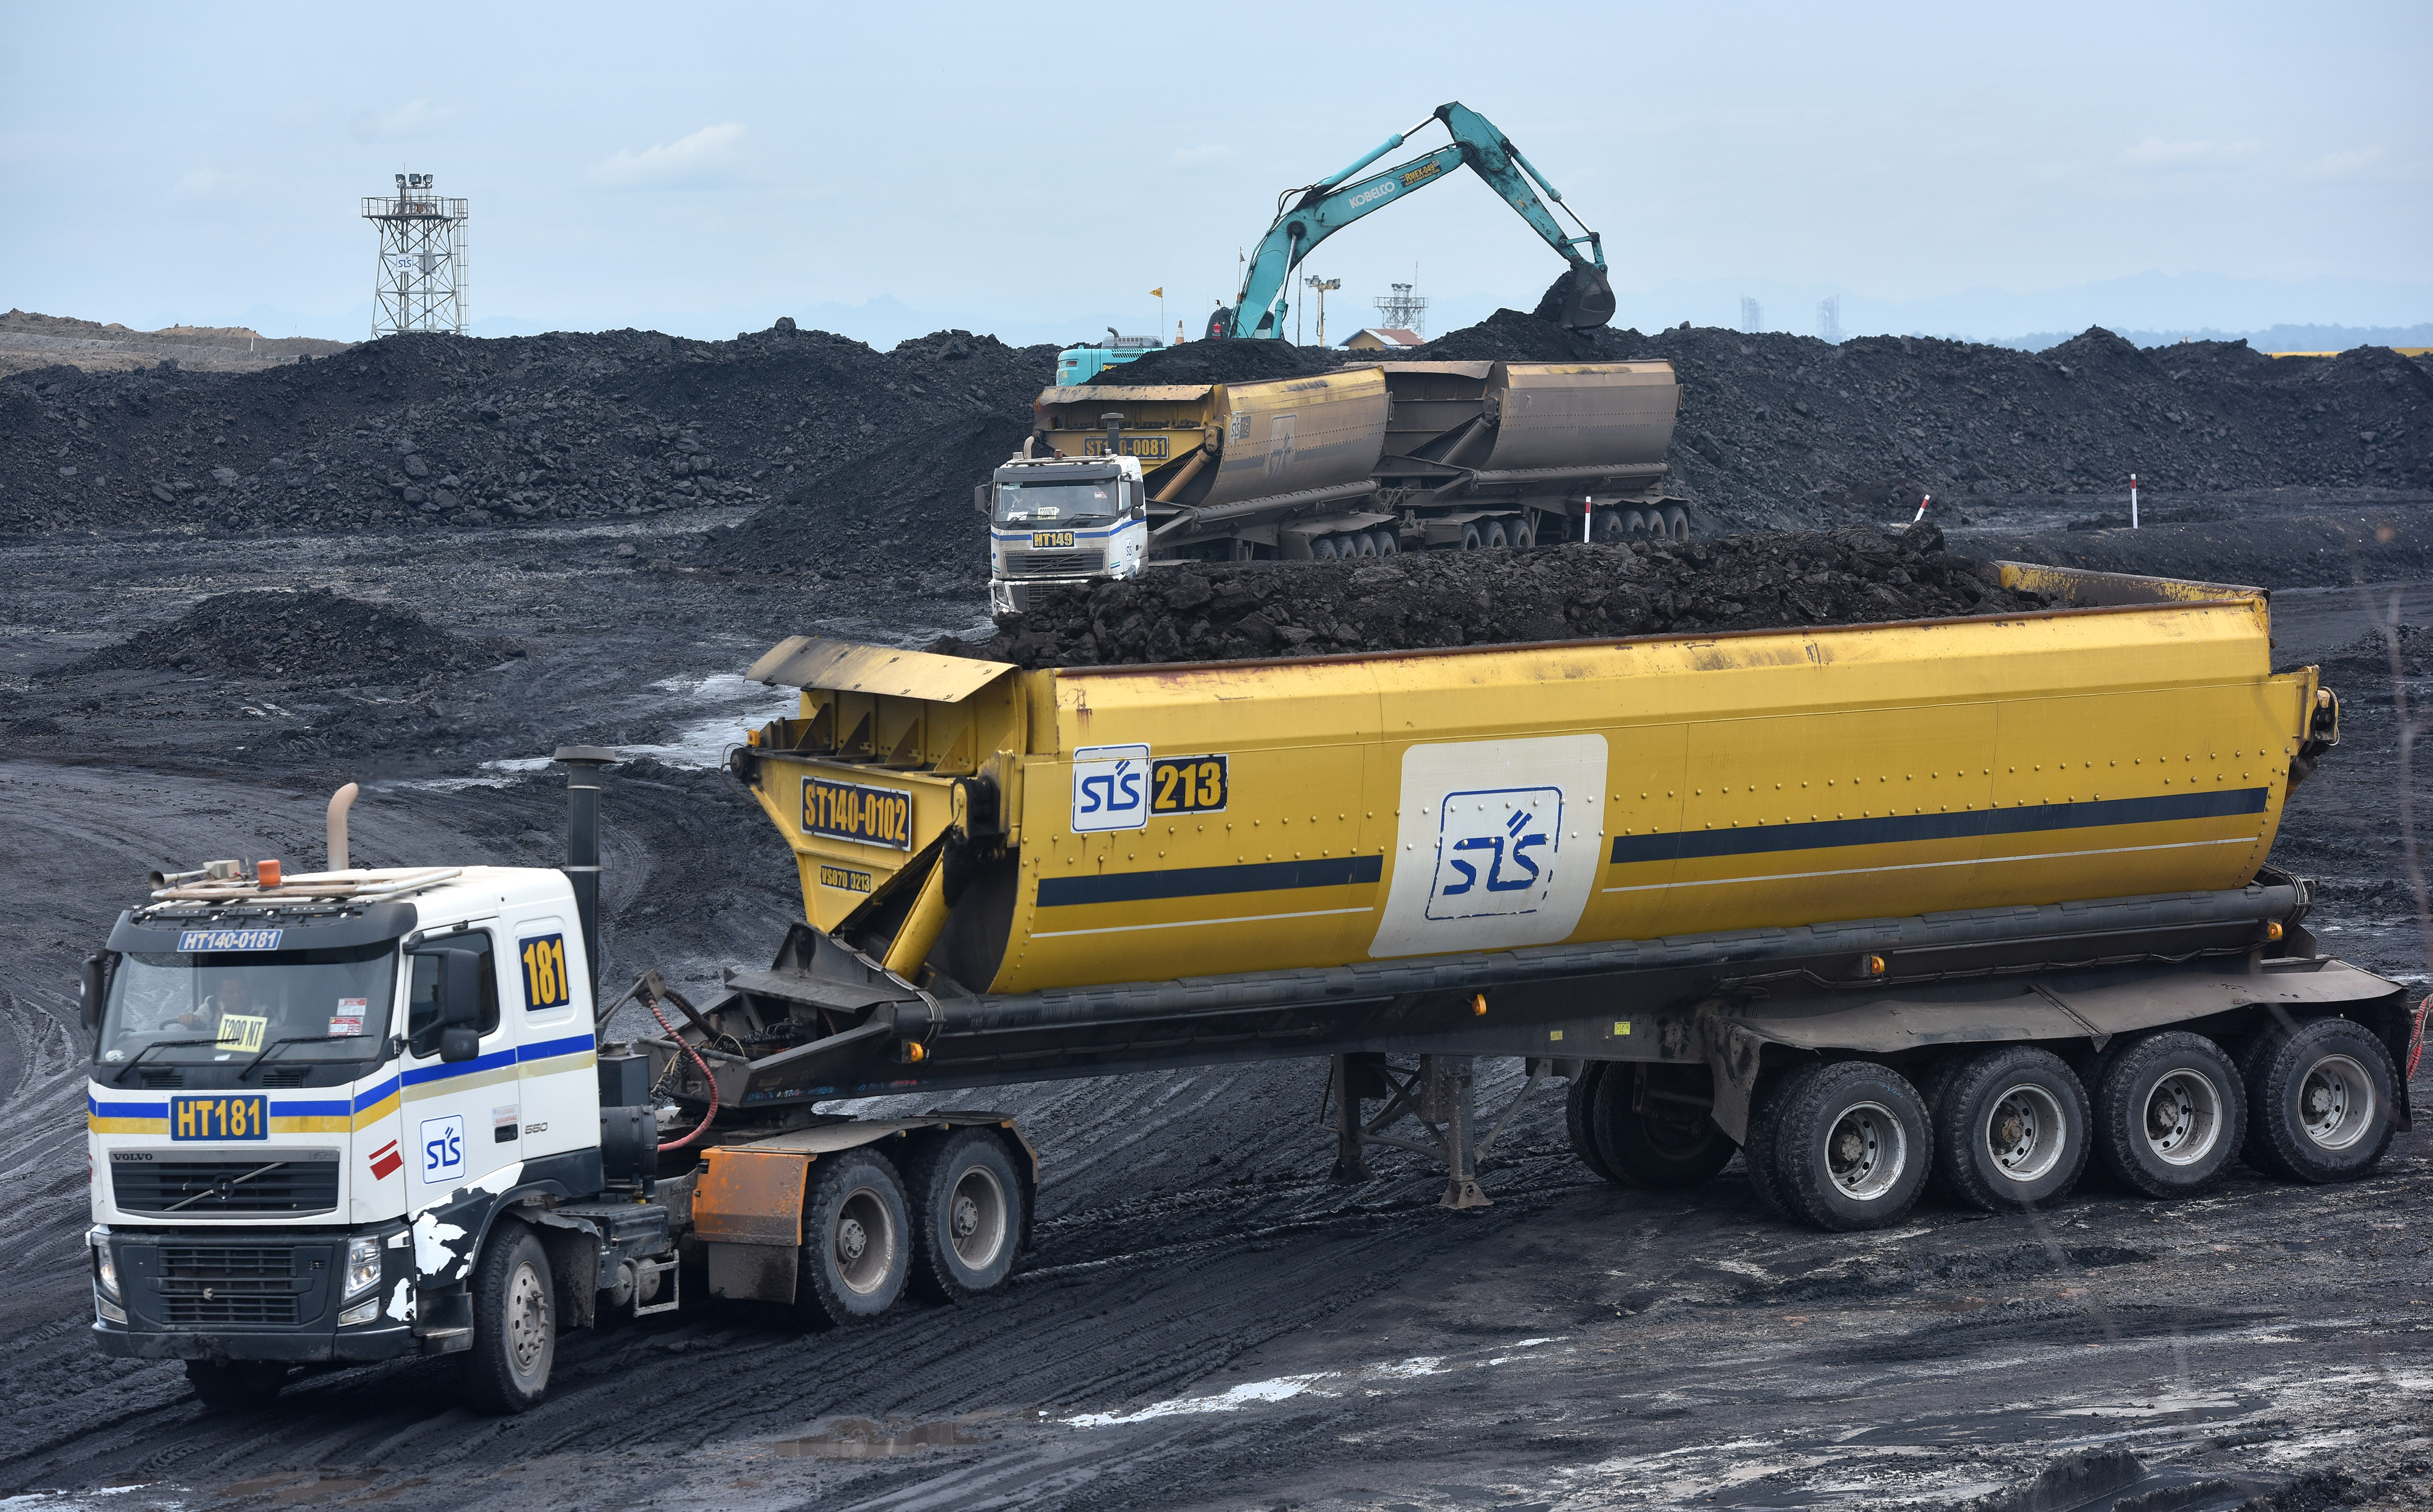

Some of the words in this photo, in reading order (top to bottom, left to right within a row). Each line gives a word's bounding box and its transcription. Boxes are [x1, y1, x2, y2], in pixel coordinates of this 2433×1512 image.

[1404, 163, 1435, 182] RMEX-049
[1414, 168, 1440, 182] CONTRACTOR
[1348, 181, 1395, 209] KOBELCO
[398, 256, 412, 268] SLS
[1231, 417, 1240, 437] SLS
[1086, 439, 1165, 456] ST10-0081
[1034, 532, 1073, 546] HT149
[1080, 760, 1140, 813] SLS
[1154, 761, 1221, 810] 213
[805, 784, 906, 841] ST140-0102
[1443, 810, 1540, 895] SLS
[183, 932, 277, 949] HT140-0181
[523, 938, 567, 1006] 181
[220, 1019, 247, 1046] T200
[246, 1021, 263, 1047] NT
[178, 1098, 260, 1137] HT181
[426, 1126, 460, 1170] SLS
